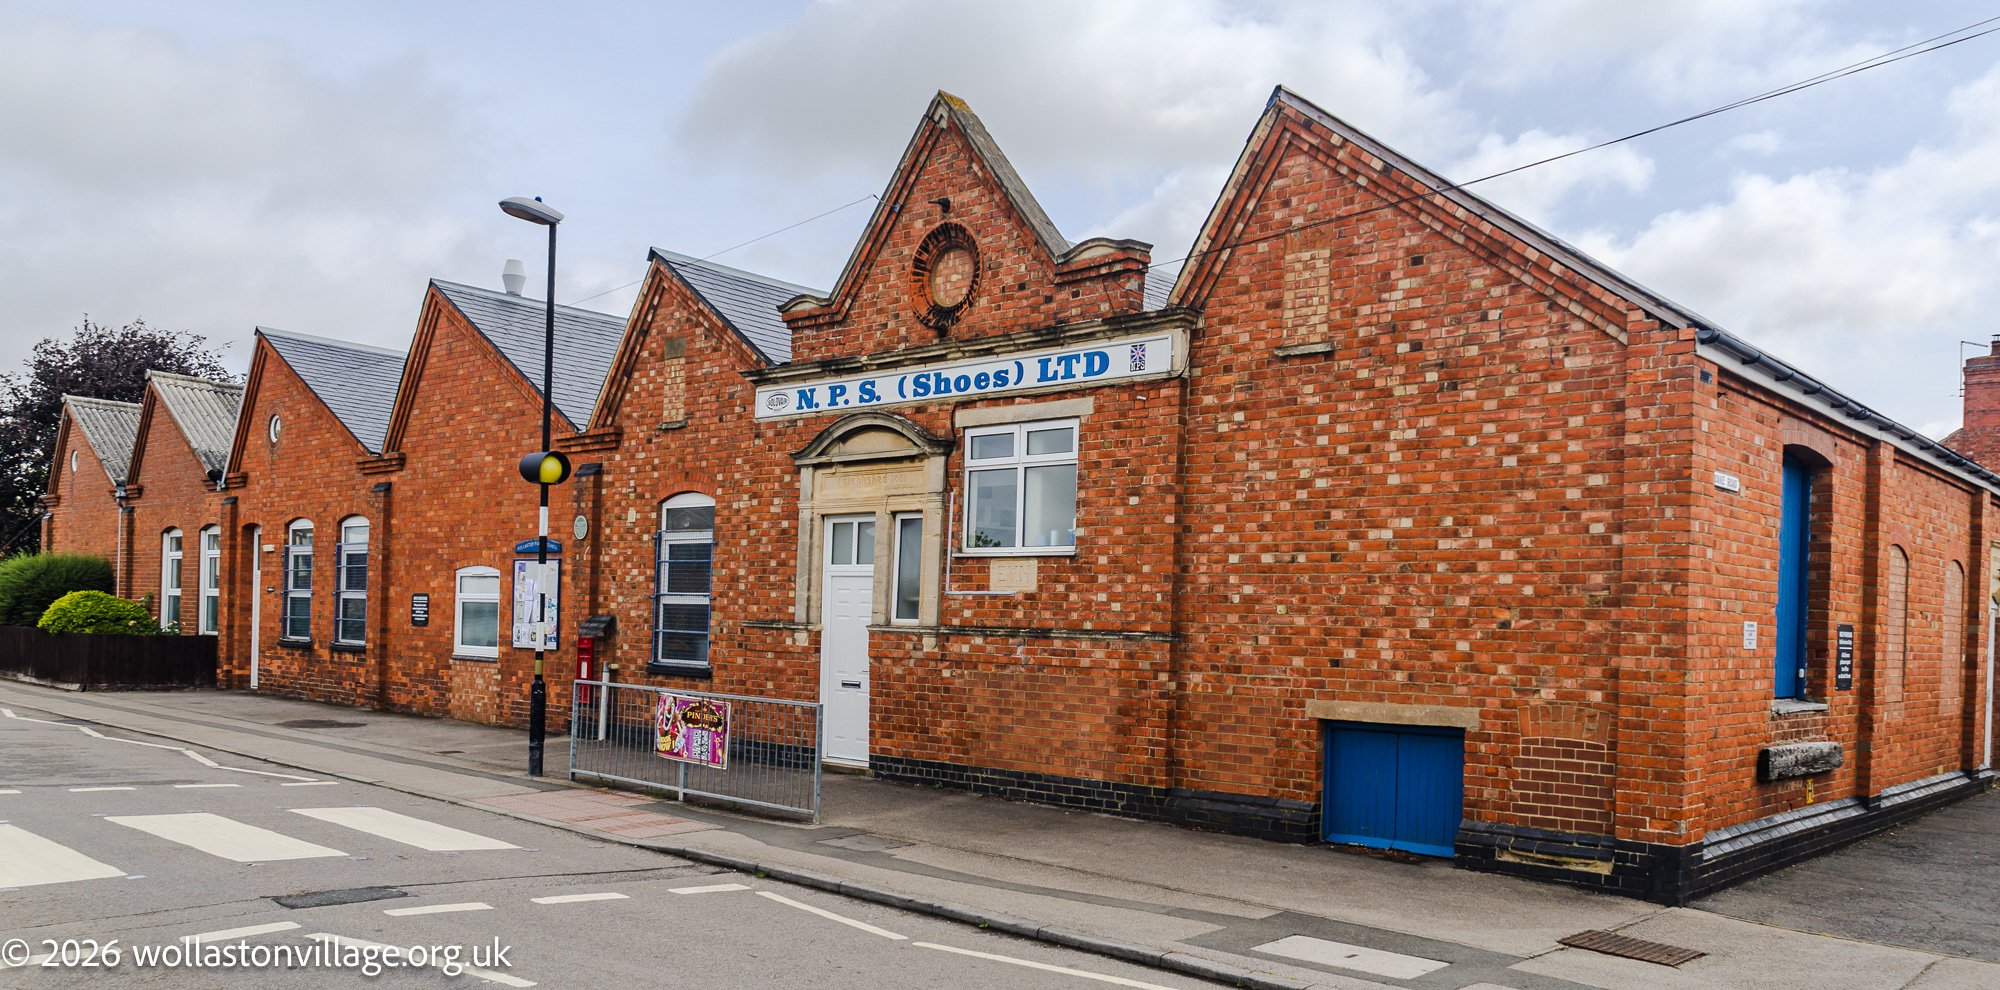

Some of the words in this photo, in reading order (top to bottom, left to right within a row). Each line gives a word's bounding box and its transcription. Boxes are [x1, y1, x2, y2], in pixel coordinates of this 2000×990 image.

[797, 388, 820, 411] N.
[828, 384, 850, 407] P.
[858, 380, 882, 404] S.
[898, 361, 1024, 400] (Shoes)
[1037, 350, 1110, 383] LTD
[1130, 360, 1145, 371] NPS
